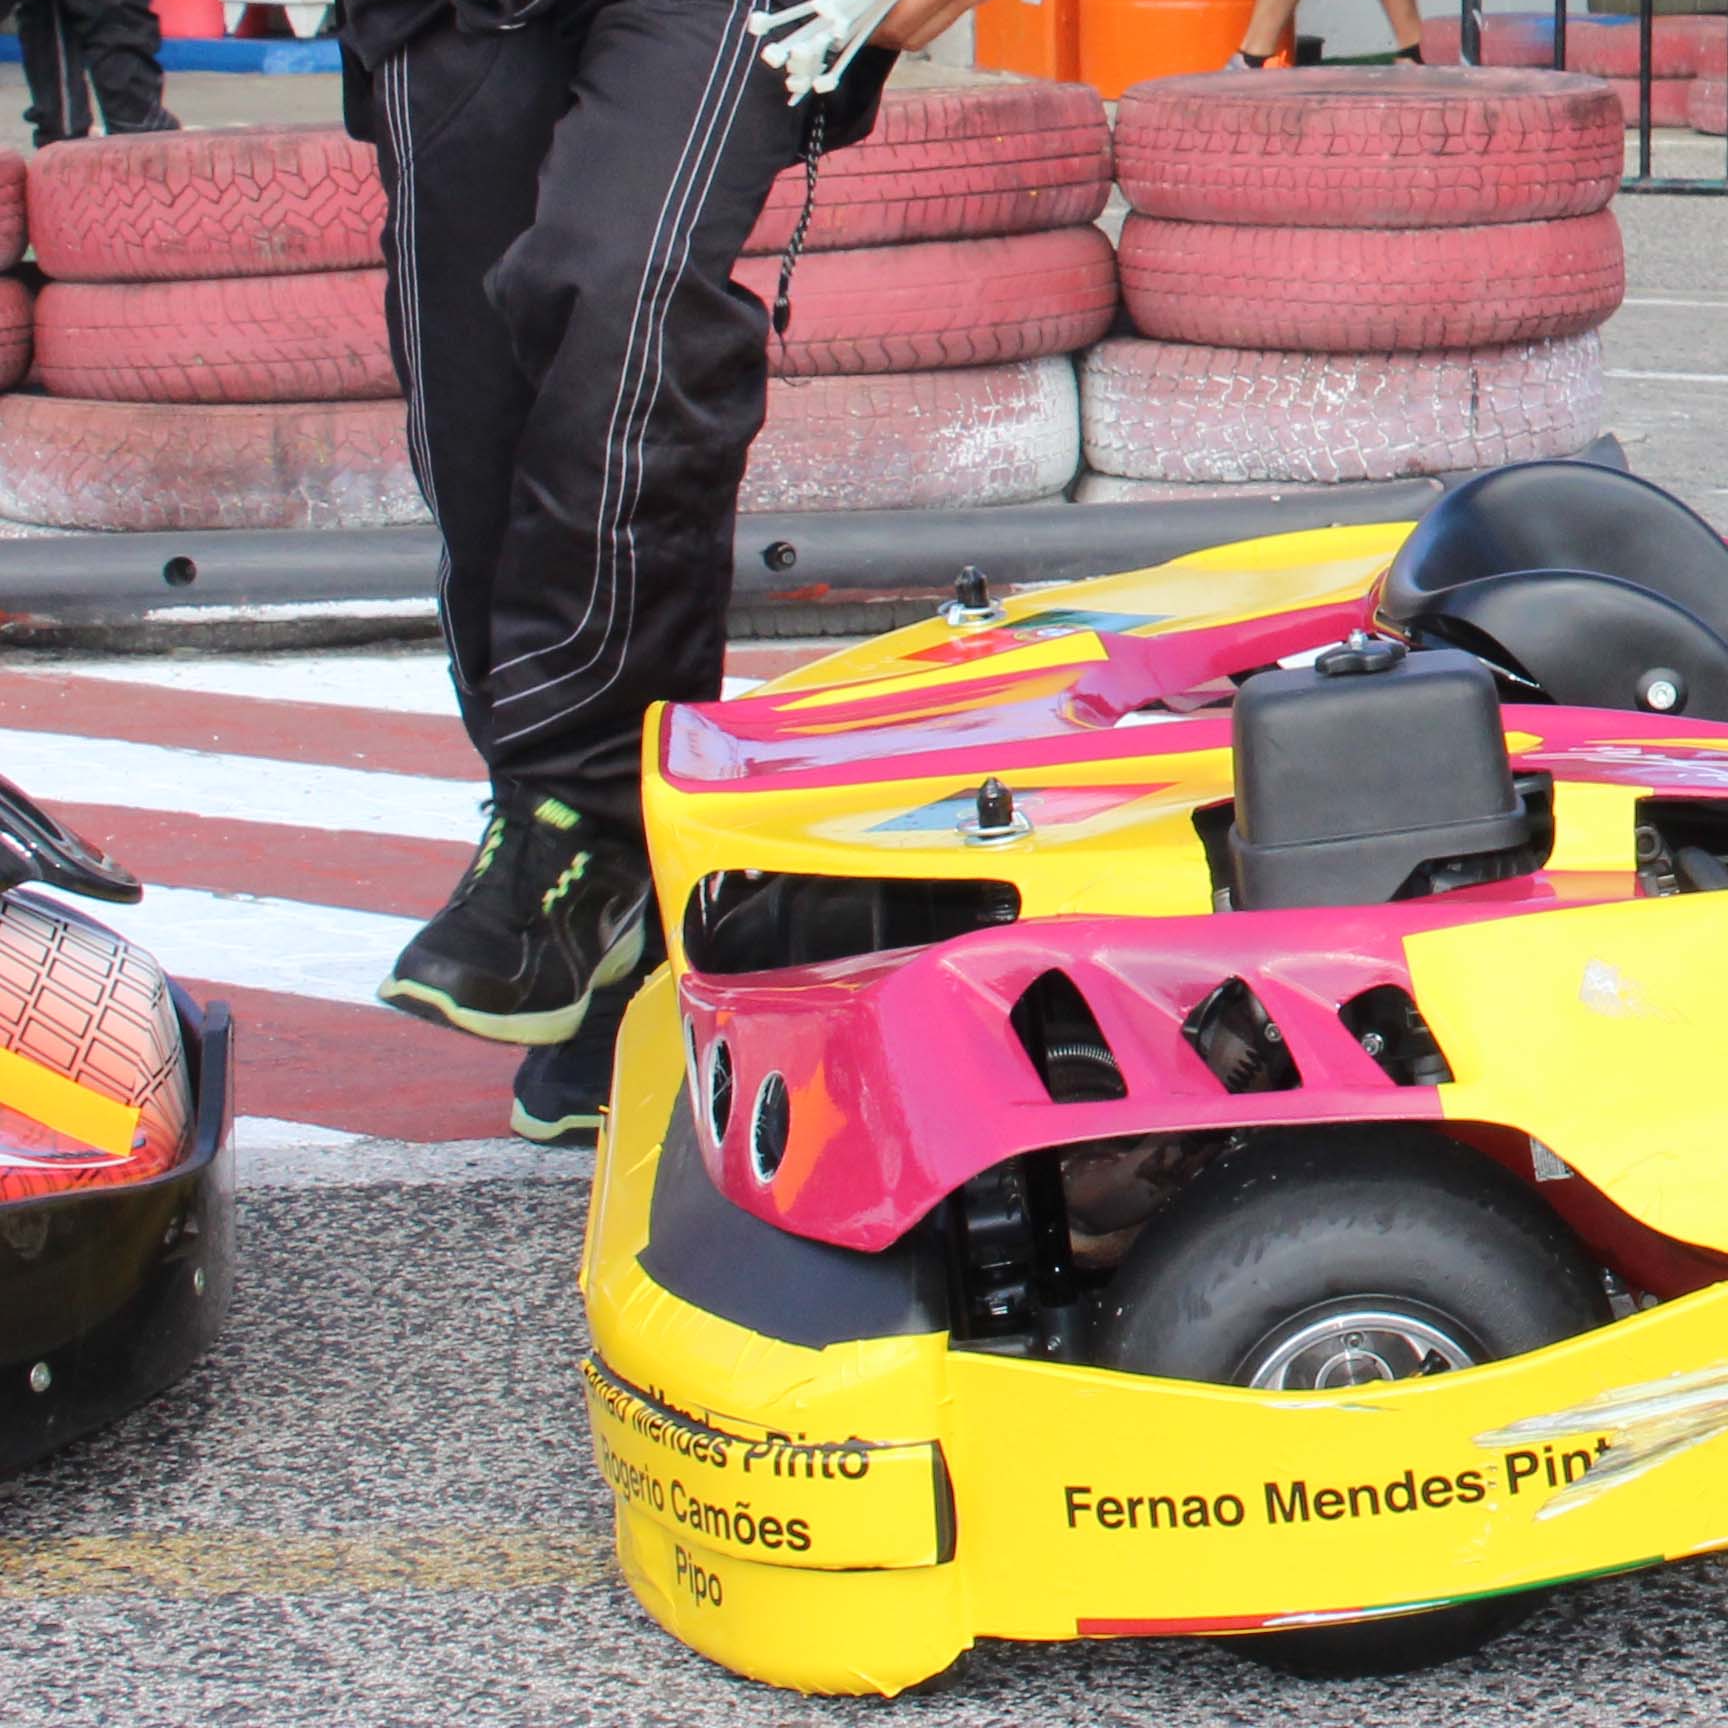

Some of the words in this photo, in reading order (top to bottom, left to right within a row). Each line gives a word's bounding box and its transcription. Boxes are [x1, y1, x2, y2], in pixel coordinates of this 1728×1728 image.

[601, 1434, 665, 1512] Rogerio
[670, 1479, 812, 1552] Camões
[1063, 1486, 1246, 1529] Fernao
[1263, 1469, 1486, 1525] Mendes
[675, 1543, 723, 1607] Pipo
